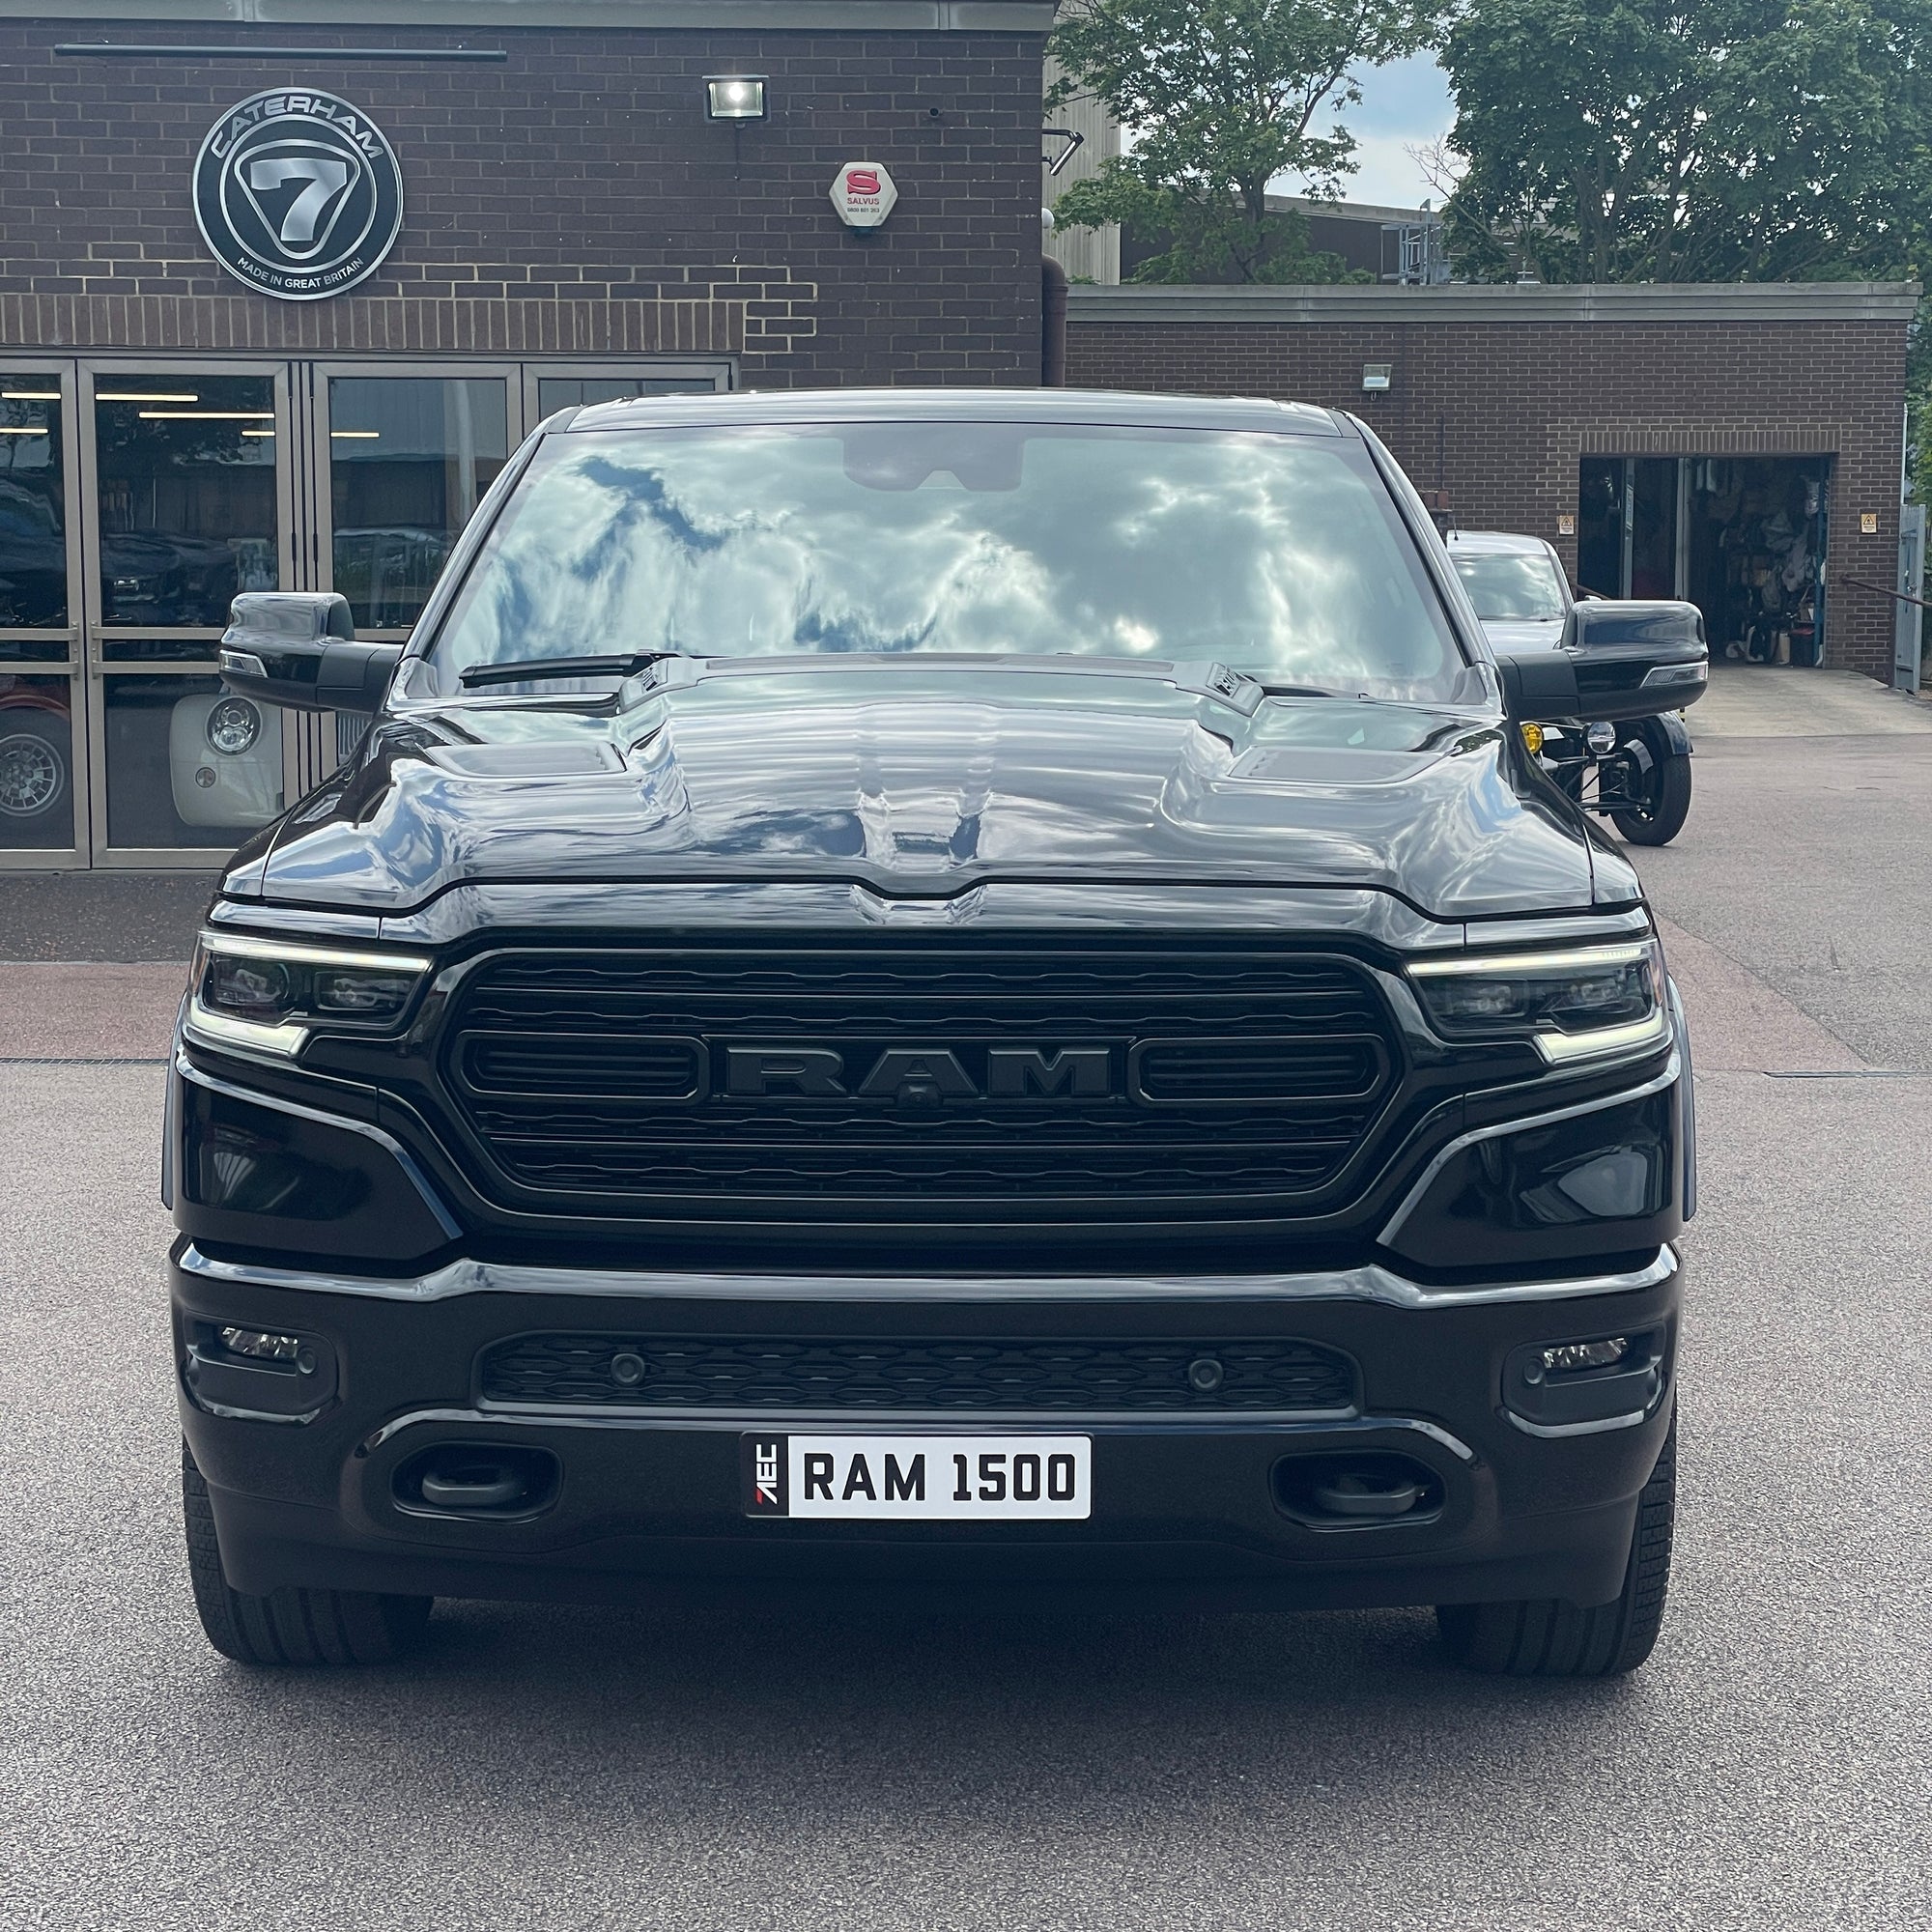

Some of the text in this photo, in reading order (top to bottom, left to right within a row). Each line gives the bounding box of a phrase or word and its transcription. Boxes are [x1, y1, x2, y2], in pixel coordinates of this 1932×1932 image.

[211, 96, 384, 158] CATERHAM
[250, 157, 348, 242] 7
[237, 257, 364, 289] MADE IN GREAT BRITAIN
[726, 1046, 1111, 1095] RAM
[755, 1443, 778, 1505] AEC
[804, 1453, 1076, 1501] RAM 1500
